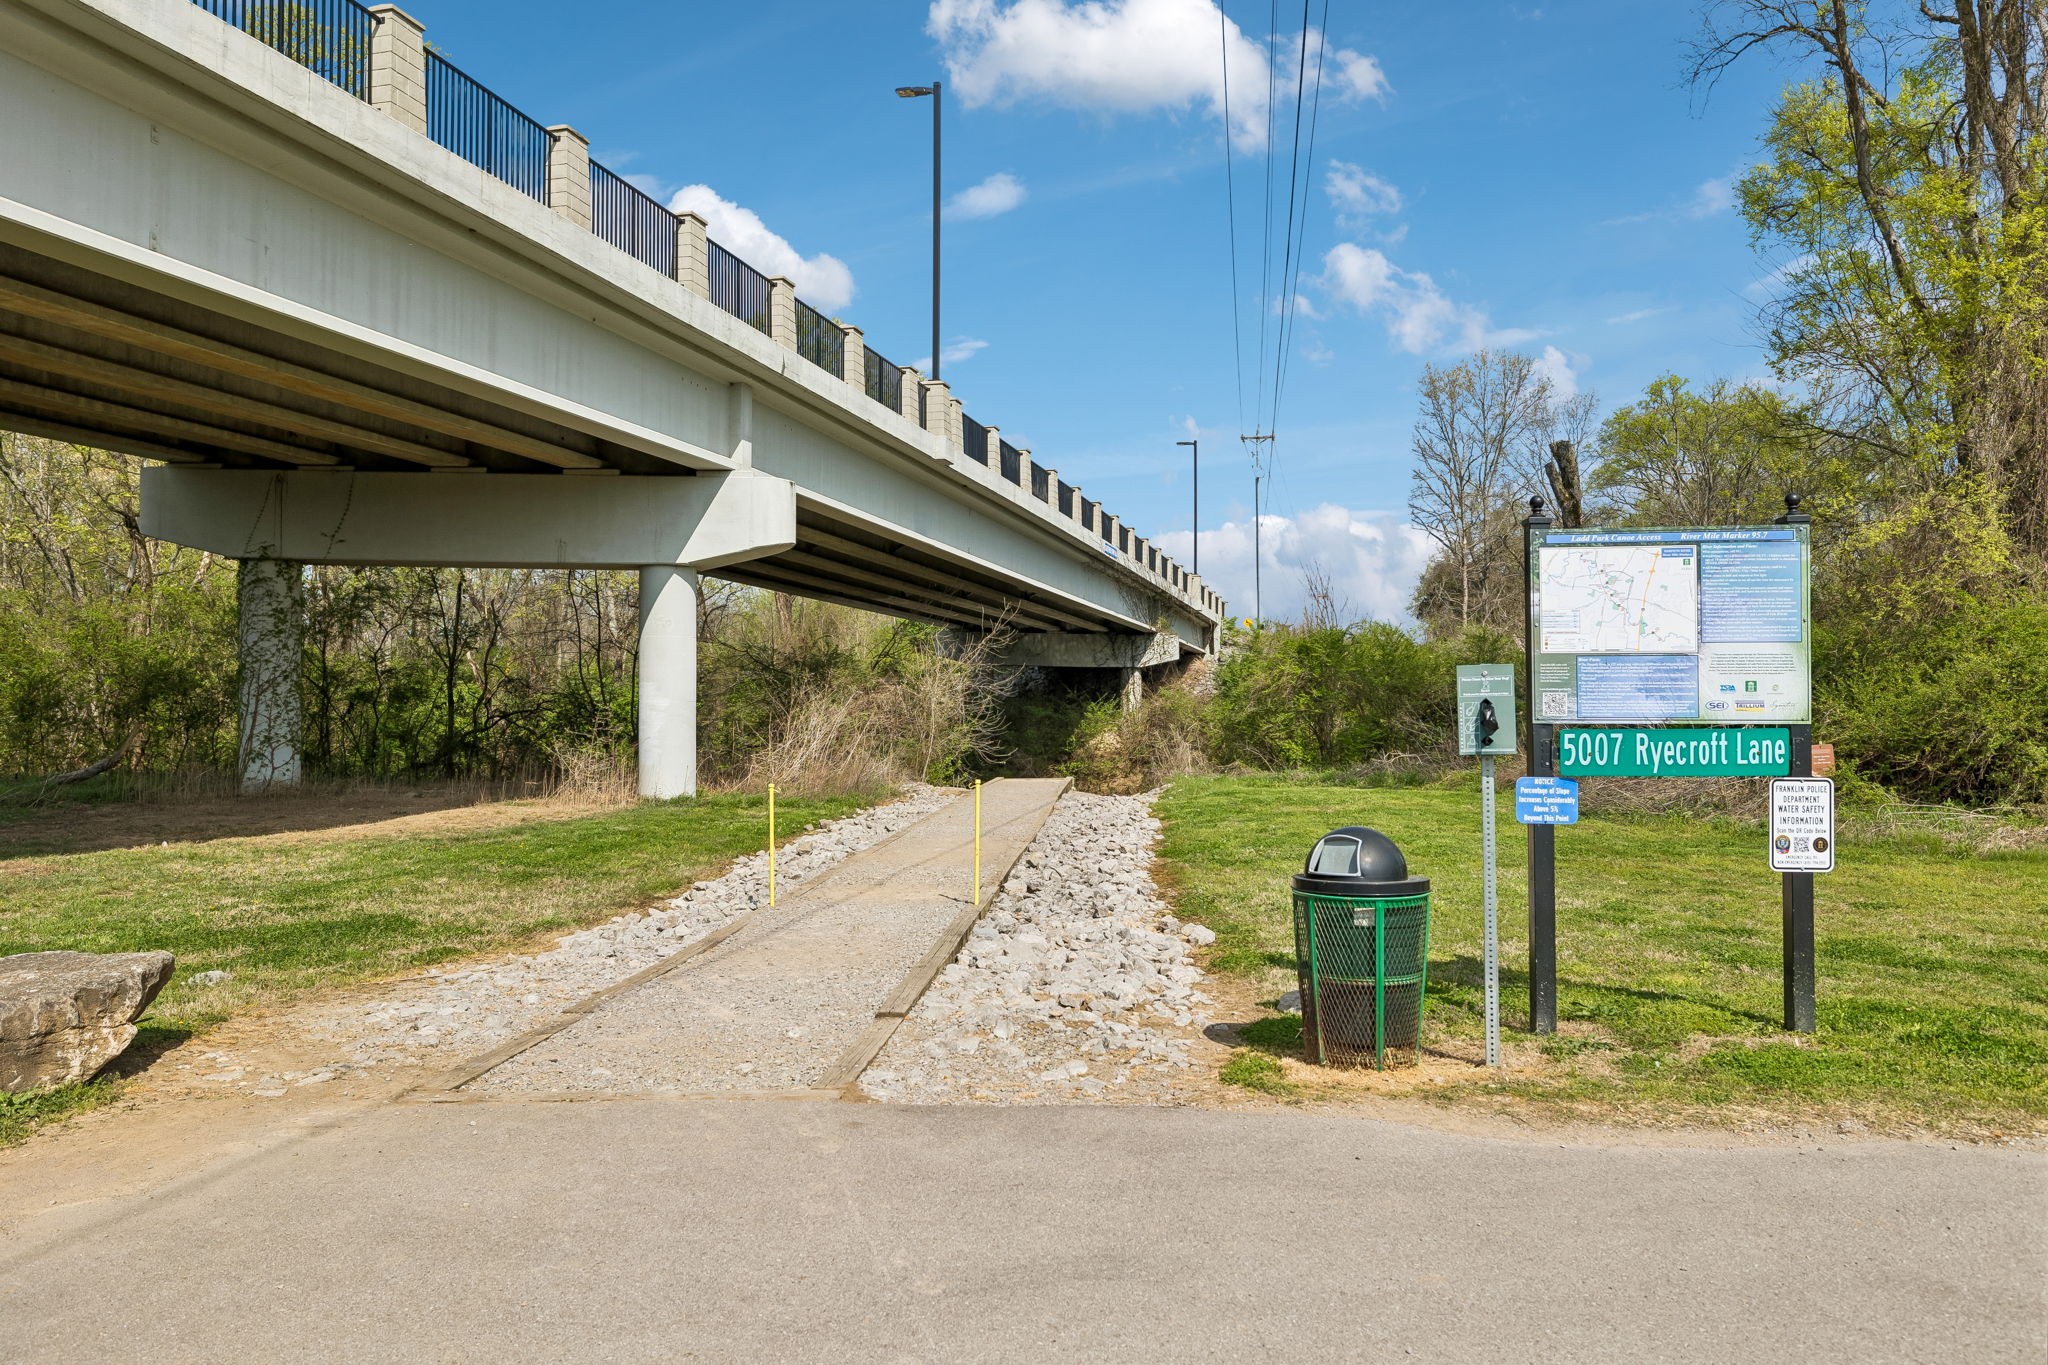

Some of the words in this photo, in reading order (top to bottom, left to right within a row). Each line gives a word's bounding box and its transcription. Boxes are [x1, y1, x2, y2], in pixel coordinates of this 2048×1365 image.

[1571, 534, 1590, 542] Ladd
[1591, 534, 1609, 542] Park
[1636, 533, 1662, 541] Access
[1680, 532, 1701, 540] River
[1751, 531, 1768, 539] 95.7
[1563, 733, 1623, 766] 5007
[1636, 732, 1728, 774] Ryecroft
[1736, 732, 1786, 765] Lane
[1520, 787, 1548, 795] Percentage
[1556, 787, 1570, 795] Slope
[1775, 785, 1805, 793] FRANKLIN
[1807, 785, 1828, 793] POLICE
[1543, 797, 1575, 805] Considerably
[1783, 795, 1820, 803] DEPARTMENT
[1778, 805, 1799, 813] WATER
[1801, 805, 1825, 814] SAFETY
[1524, 814, 1542, 822] Beyond
[1780, 816, 1824, 825] INFORMATION
